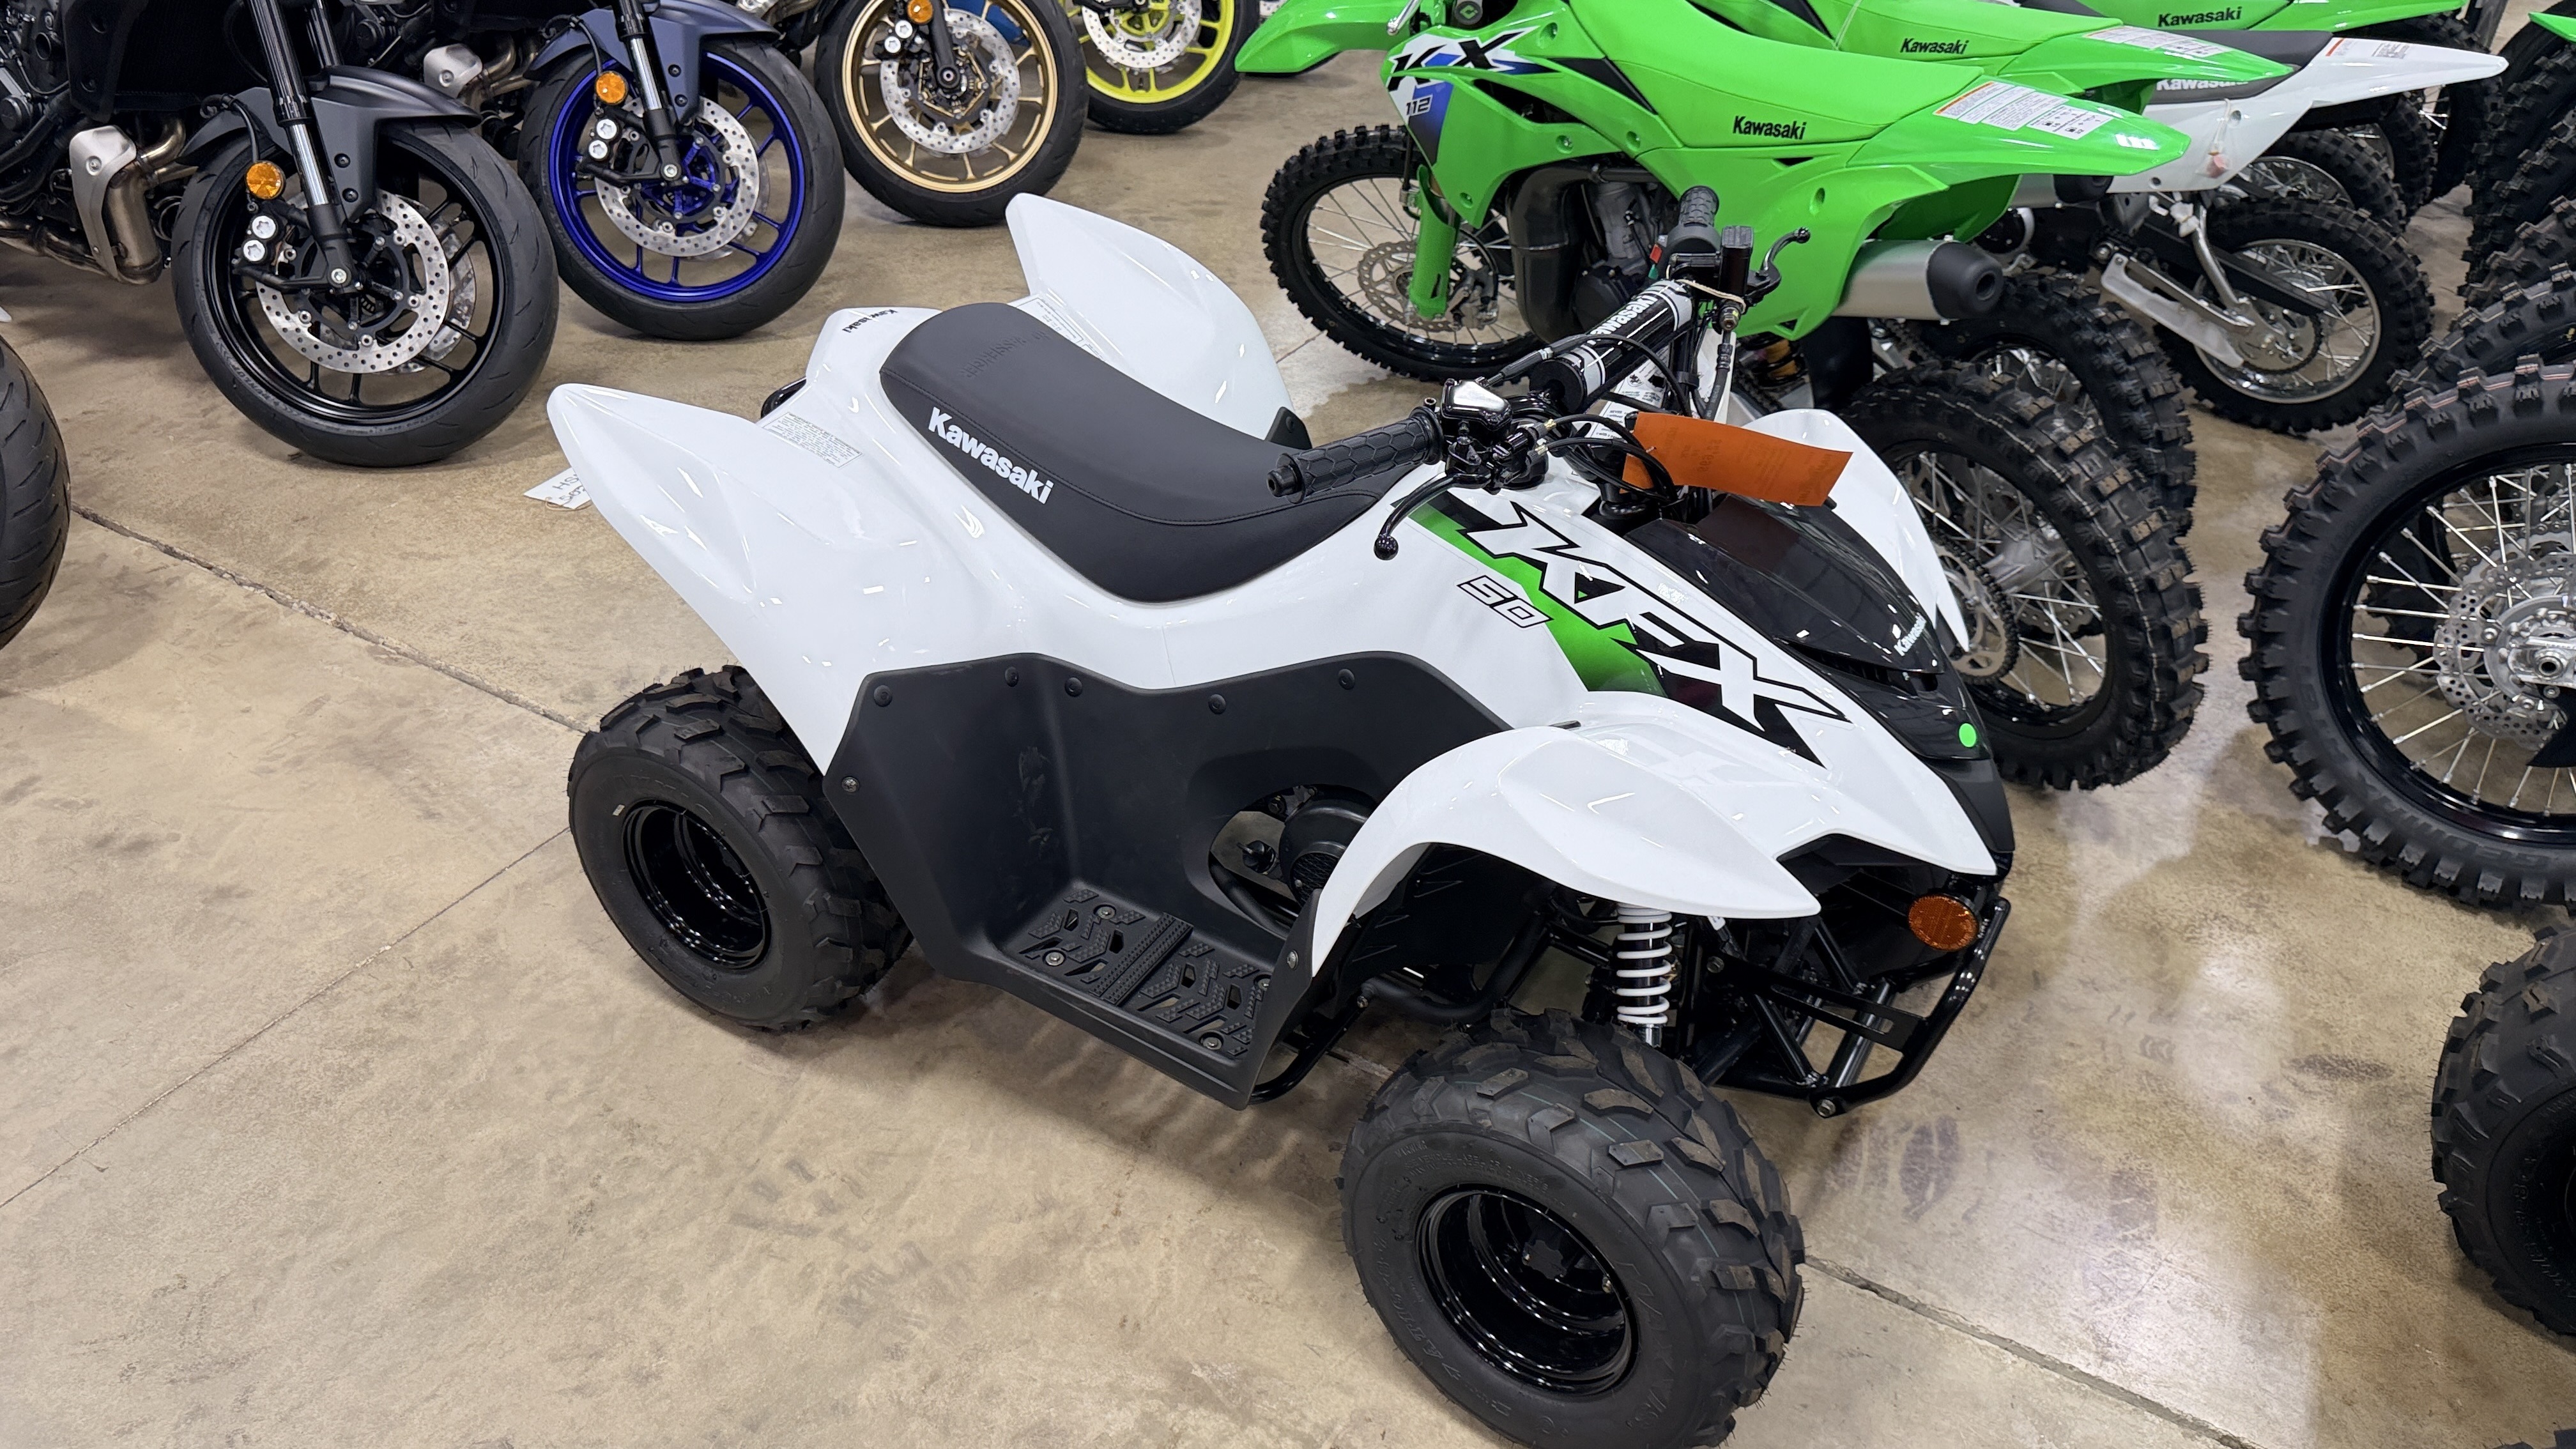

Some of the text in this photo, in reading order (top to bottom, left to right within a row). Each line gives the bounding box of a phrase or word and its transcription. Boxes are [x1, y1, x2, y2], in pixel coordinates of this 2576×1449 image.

[2158, 6, 2242, 27] Kawasaki
[1388, 31, 1526, 91] KX
[1899, 38, 1969, 54] Kawasaki
[1406, 96, 1432, 115] 112
[1733, 115, 1807, 140] Kawasaki
[1587, 295, 1658, 346] awasaki
[928, 406, 1054, 504] Kawasaki
[1453, 499, 1855, 733] KFX
[1457, 575, 1554, 628] 50
[1893, 612, 1927, 656] Kawasaki
